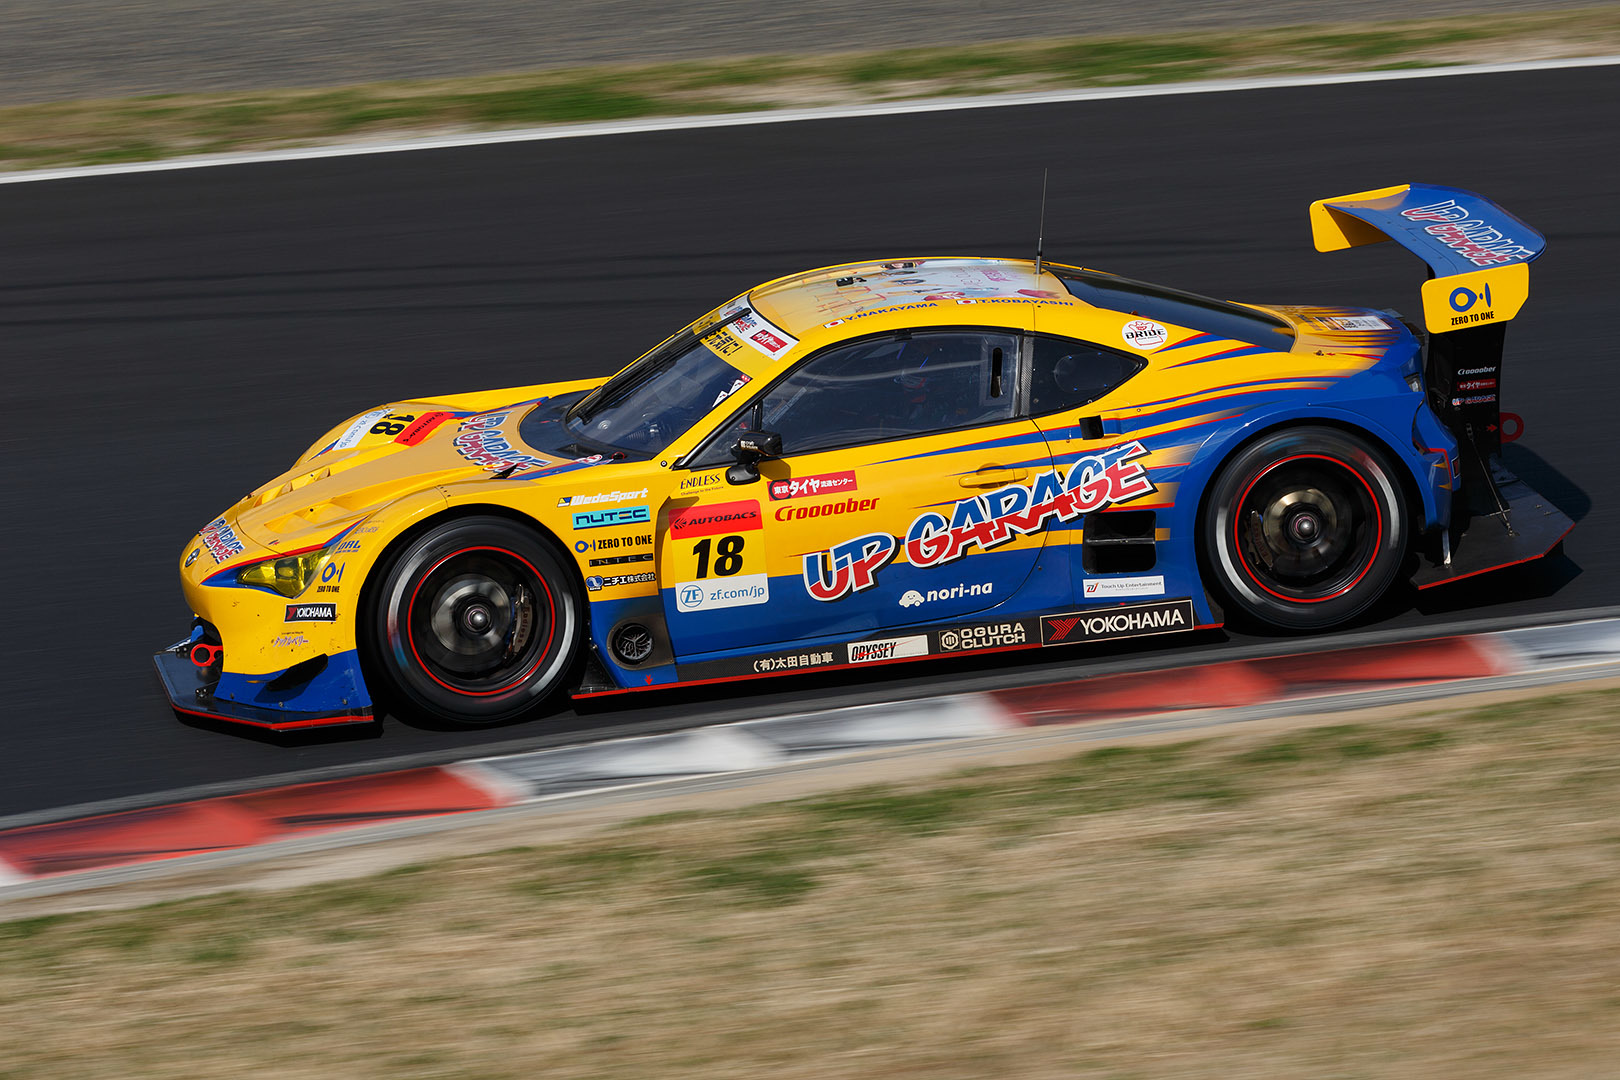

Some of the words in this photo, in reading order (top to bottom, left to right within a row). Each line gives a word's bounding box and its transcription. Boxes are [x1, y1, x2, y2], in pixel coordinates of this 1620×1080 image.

[1401, 200, 1469, 222] UP
[1425, 220, 1536, 266] GARAGE
[979, 298, 1073, 307] T.KOBAYASHI
[846, 303, 938, 321] Y.NAKAYAMA
[1451, 315, 1469, 325] ZERO
[1469, 313, 1480, 322] TO
[1480, 311, 1495, 320] ONE
[1125, 329, 1165, 339] BRIDE
[370, 414, 415, 435] 18
[458, 410, 514, 432] UP
[680, 474, 720, 490] ENDLESS
[570, 488, 648, 506] WedsSport
[688, 511, 757, 526] AUTOBACS
[775, 498, 880, 521] Croooober
[803, 532, 900, 602] UP
[905, 440, 1158, 568] GARAGE
[598, 538, 620, 549] ZERO
[621, 536, 633, 547] TO
[635, 535, 653, 545] ONE
[693, 535, 745, 579] 18
[710, 586, 765, 601] zf.com/jp
[927, 581, 993, 602] nori-na
[960, 622, 1025, 639] OGURA
[1080, 609, 1185, 635] YOKOHAMA
[961, 632, 1026, 649] CLUTCH
[851, 642, 897, 662] ODYSSEY
